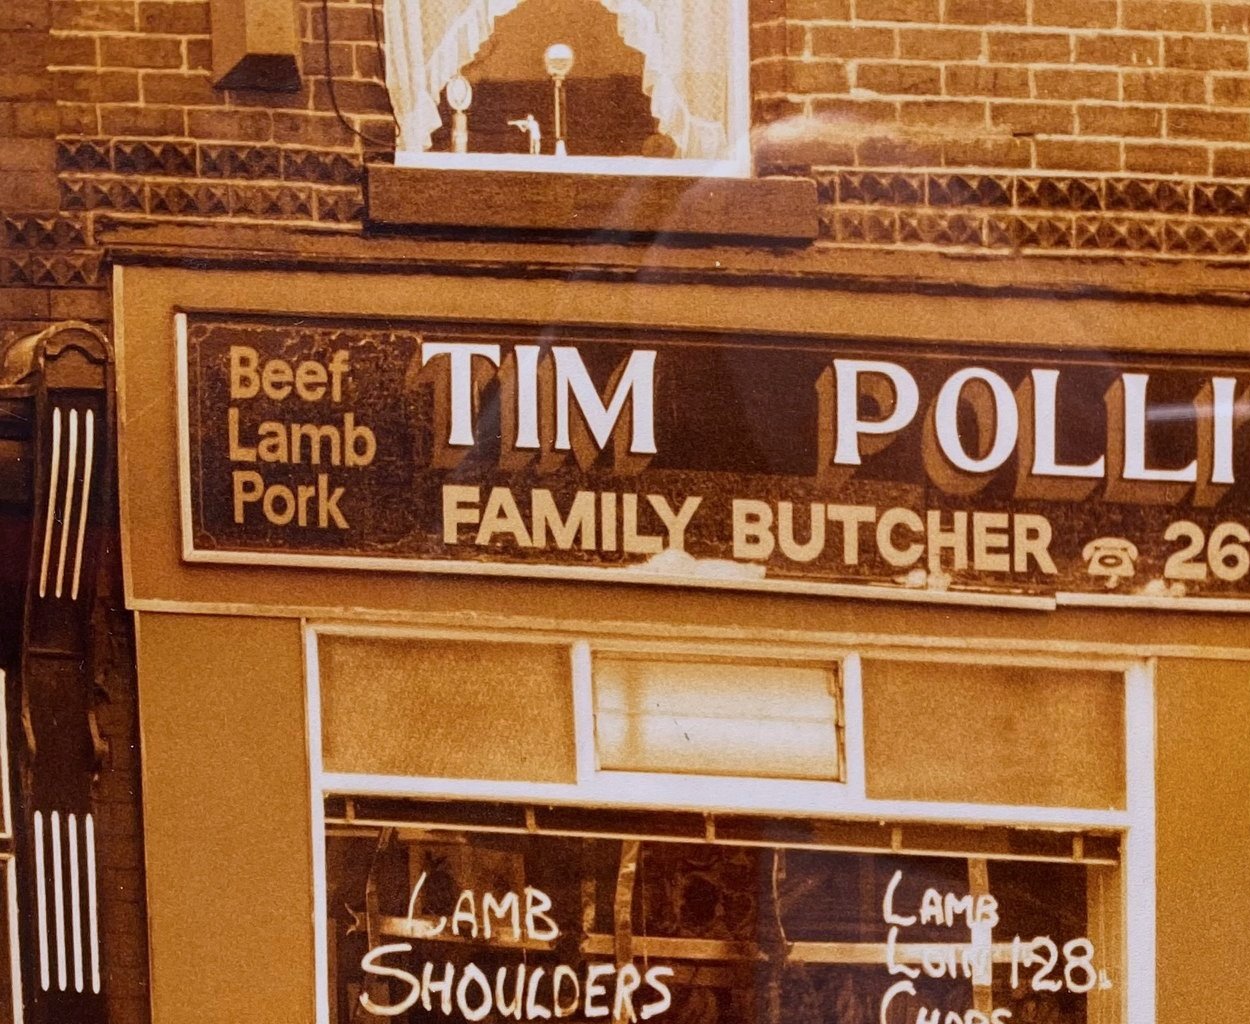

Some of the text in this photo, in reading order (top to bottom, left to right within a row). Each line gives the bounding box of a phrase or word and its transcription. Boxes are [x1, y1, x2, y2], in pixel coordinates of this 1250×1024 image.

[229, 346, 350, 403] Beef
[421, 341, 658, 456] TIM
[227, 407, 377, 468] Lamb
[231, 470, 350, 530] Pork
[442, 485, 702, 556] FAMILY
[732, 499, 1057, 576] BUTCHER
[407, 871, 560, 941] LAMB
[883, 870, 999, 928] LAMB
[359, 943, 675, 1024] SHOULDERS
